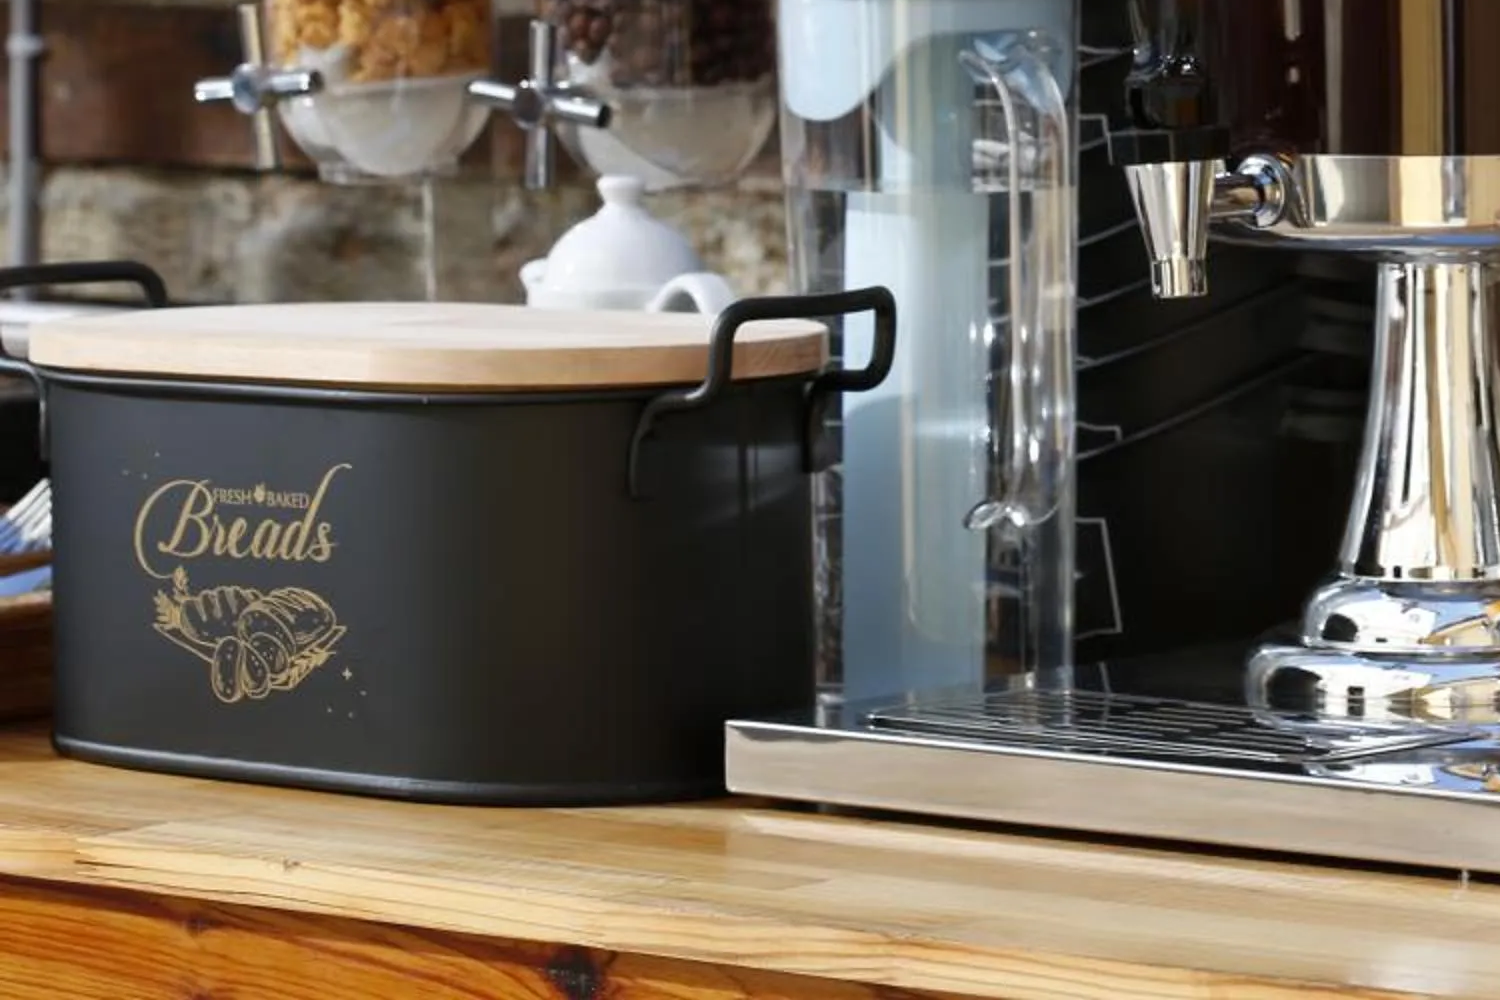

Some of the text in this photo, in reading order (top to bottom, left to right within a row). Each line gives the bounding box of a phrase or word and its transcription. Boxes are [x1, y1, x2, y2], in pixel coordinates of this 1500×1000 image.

[134, 463, 352, 579] Breads
[212, 487, 309, 509] FRESH BAKED
